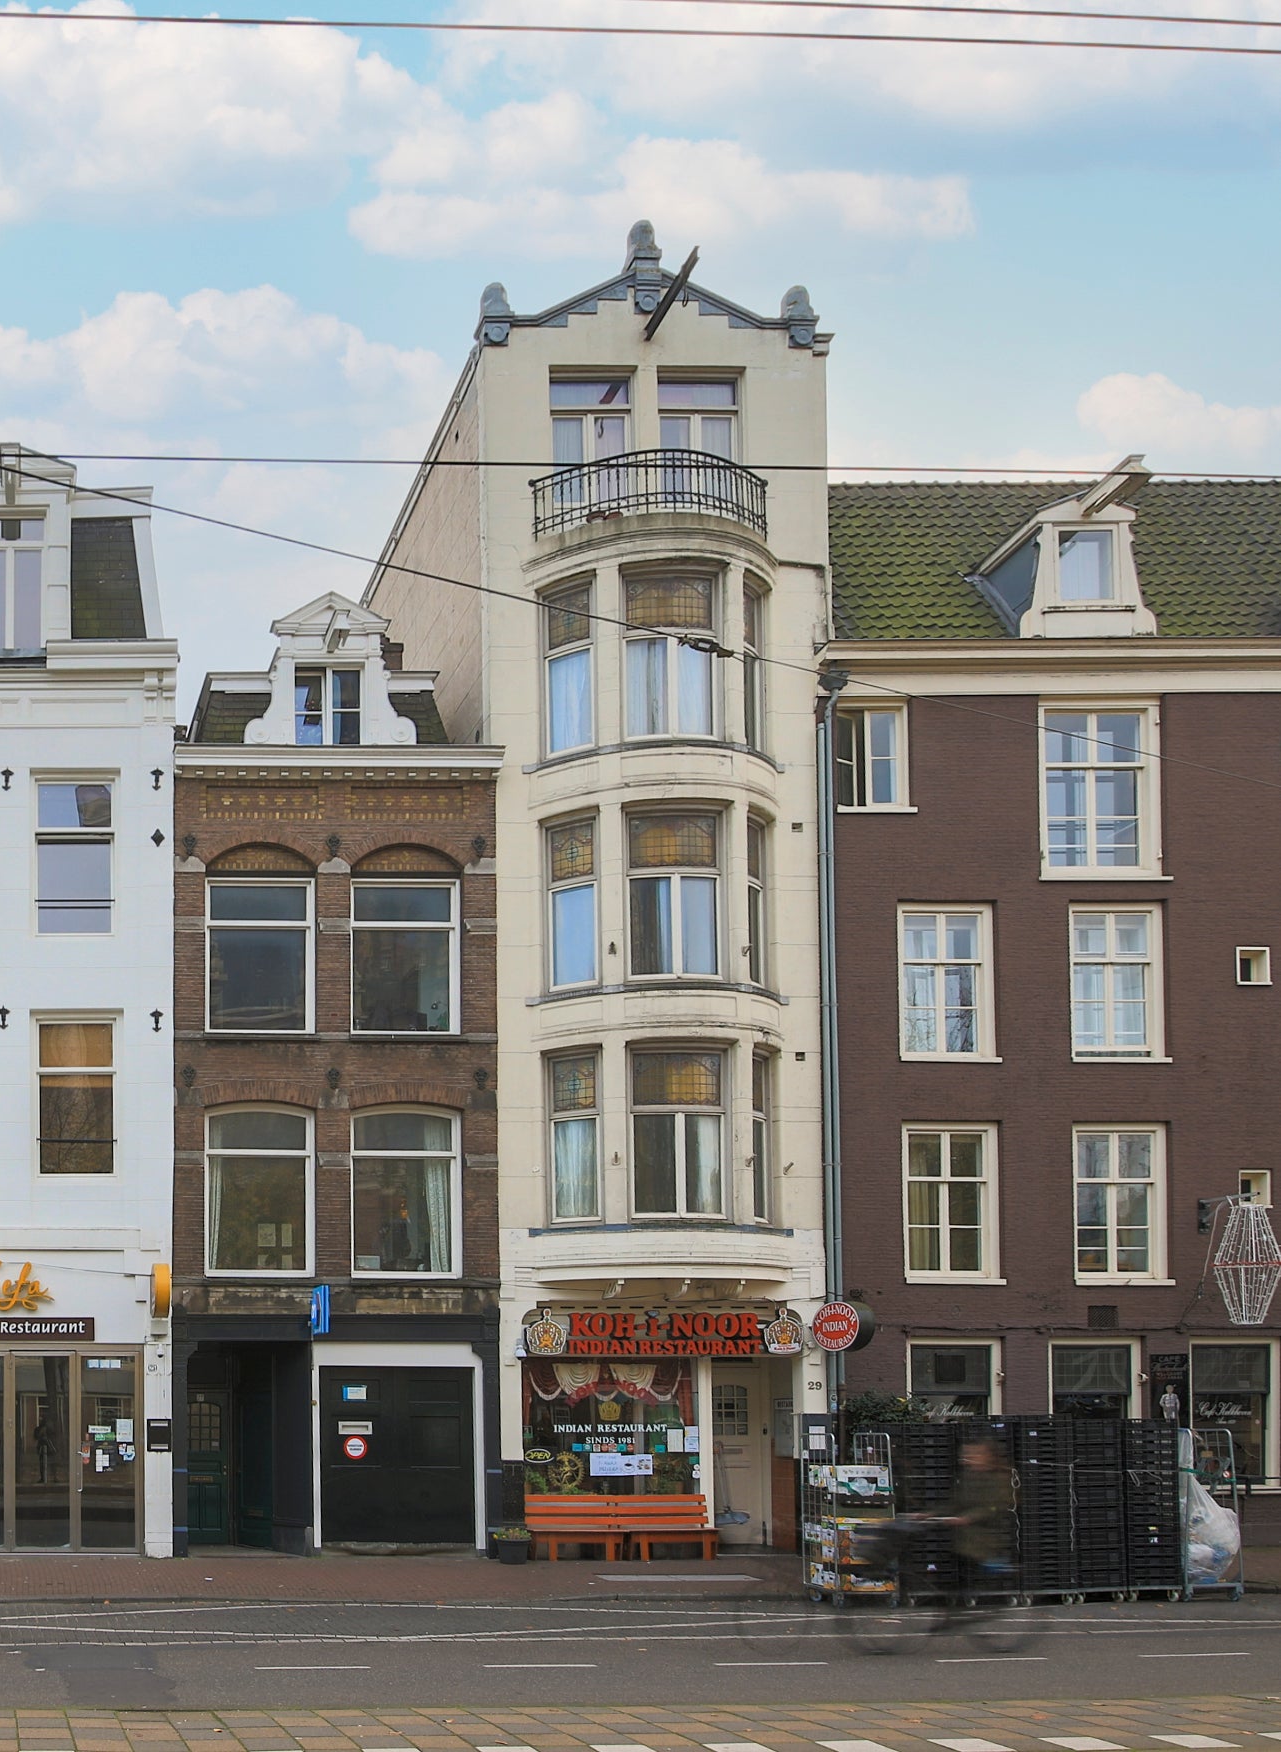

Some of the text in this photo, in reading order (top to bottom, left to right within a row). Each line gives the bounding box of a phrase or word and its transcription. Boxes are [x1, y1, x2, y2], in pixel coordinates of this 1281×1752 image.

[0, 1320, 86, 1334] Restaurant
[822, 1320, 849, 1333] INDIAN
[816, 1327, 856, 1349] RESTAURANT
[569, 1339, 763, 1356] INDIAN RESTAURANT
[807, 1381, 823, 1391] 29
[553, 1424, 668, 1433] INDIAN RESTAURANT
[585, 1436, 636, 1444] SINDS 1981
[525, 1451, 551, 1461] OPEN
